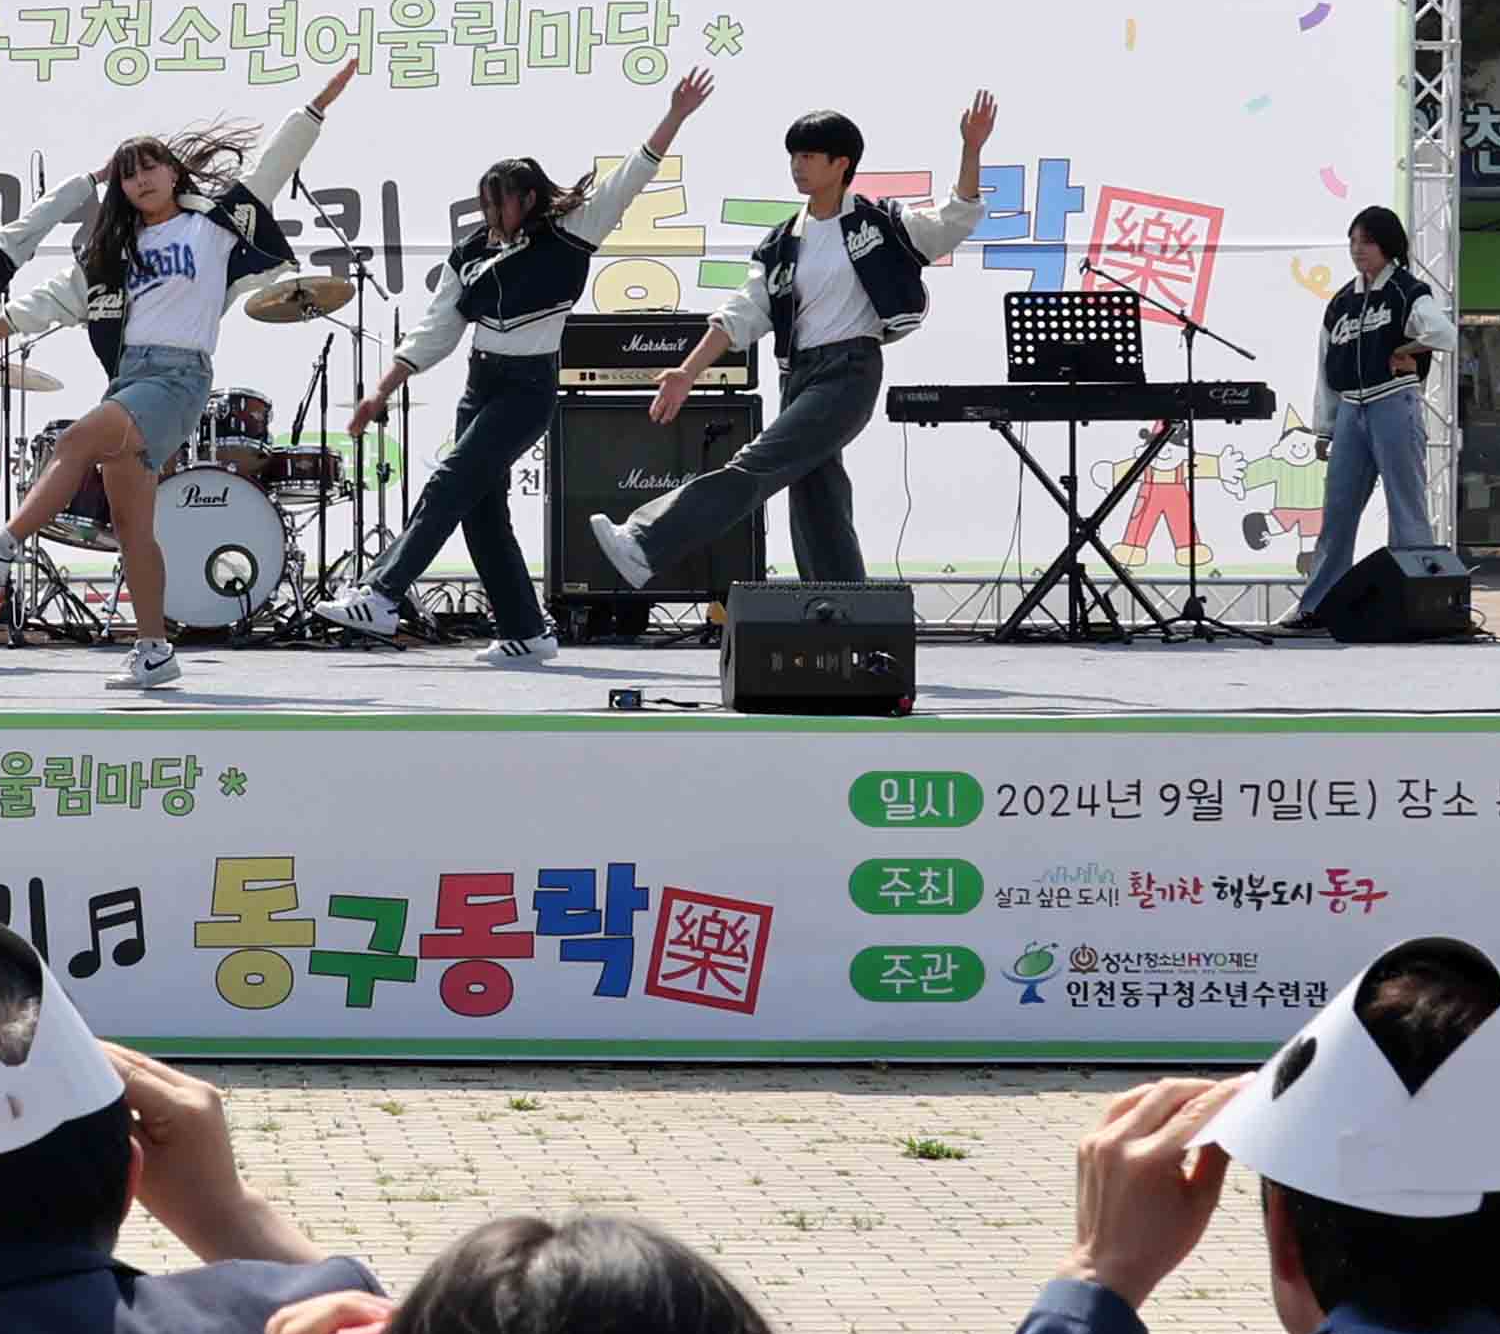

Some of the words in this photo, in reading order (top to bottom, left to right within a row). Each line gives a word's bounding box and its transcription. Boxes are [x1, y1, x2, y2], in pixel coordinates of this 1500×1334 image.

[621, 333, 689, 354] Marshall
[182, 483, 230, 508] Pearl
[879, 777, 956, 821] 일시
[996, 778, 1144, 820] 2024년
[1159, 778, 1224, 822] 9월
[1240, 778, 1377, 823] 7일(토)
[1396, 778, 1479, 821] 장소
[878, 866, 956, 908] 주최
[994, 886, 1033, 910] 살고
[1036, 886, 1074, 910] 싶은
[1076, 886, 1121, 910] 도시!
[1127, 869, 1205, 911] 활기찬
[1212, 873, 1313, 912] 행복도시
[1317, 868, 1389, 914] 동구
[194, 855, 650, 1018] 동구동락
[662, 903, 752, 997] 樂
[878, 952, 960, 996] 주관
[1065, 979, 1330, 1009] 인천동구청소년수련관
